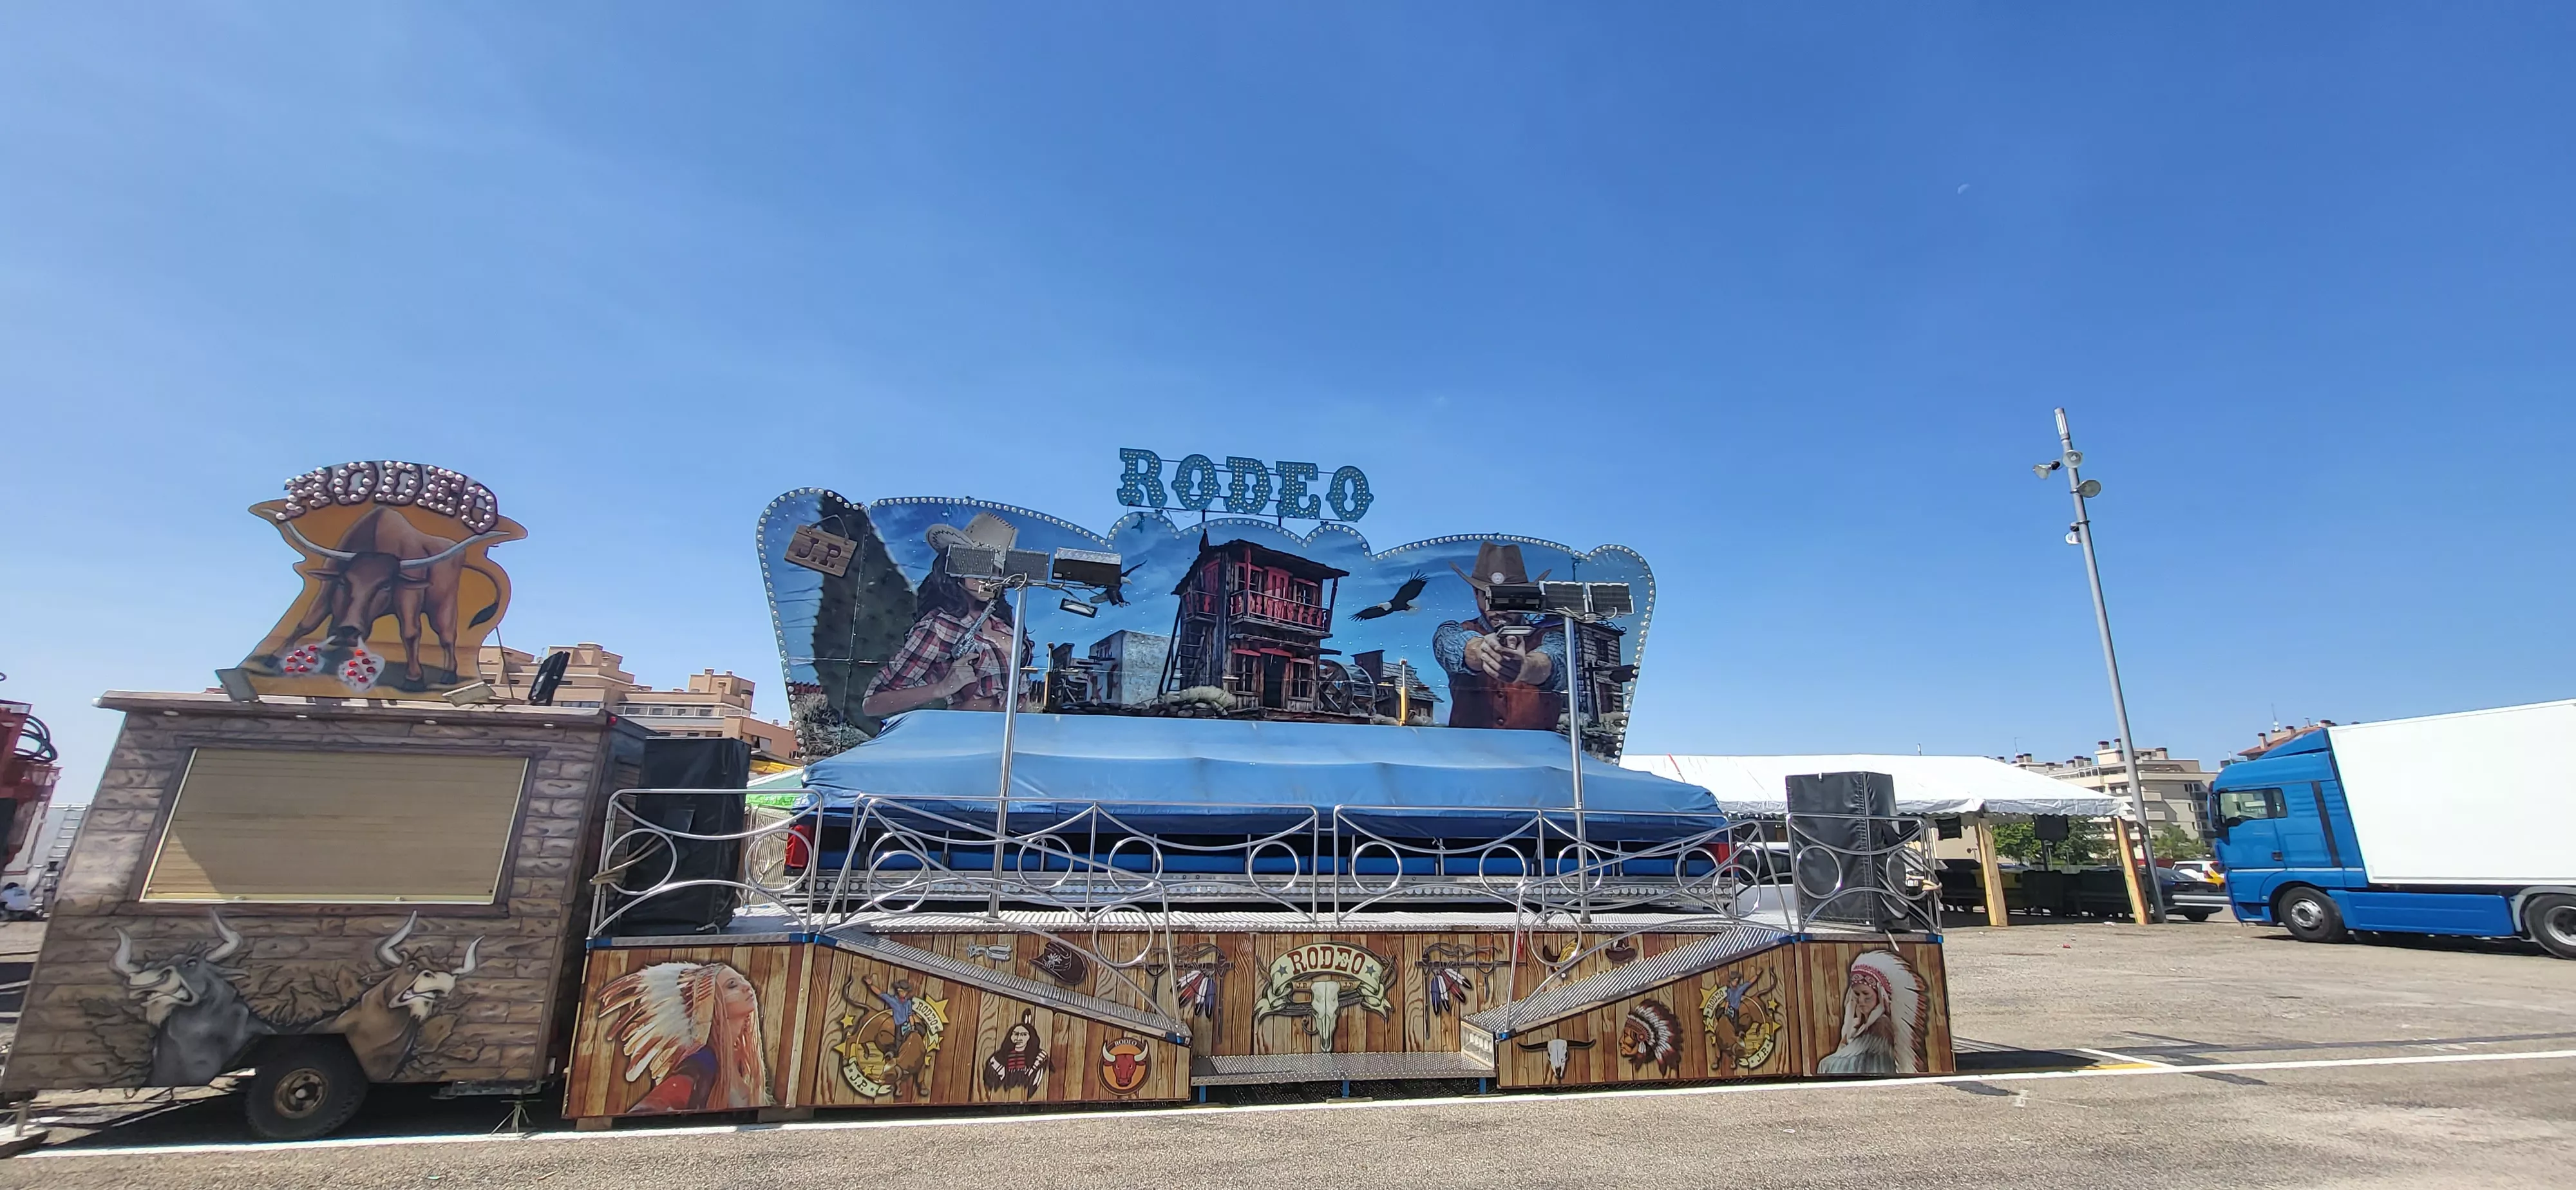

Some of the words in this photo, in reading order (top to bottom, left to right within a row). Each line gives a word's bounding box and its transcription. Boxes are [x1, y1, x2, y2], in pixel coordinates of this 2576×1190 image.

[276, 460, 498, 534] RODEO
[1117, 448, 1374, 522] RODEO
[795, 537, 841, 568] J.P.
[1287, 946, 1365, 975] RODEO
[917, 1001, 938, 1026] RODEO
[1707, 990, 1724, 1010] RODEO
[1757, 1047, 1768, 1062] J.P.
[849, 1075, 868, 1091] J.P.
